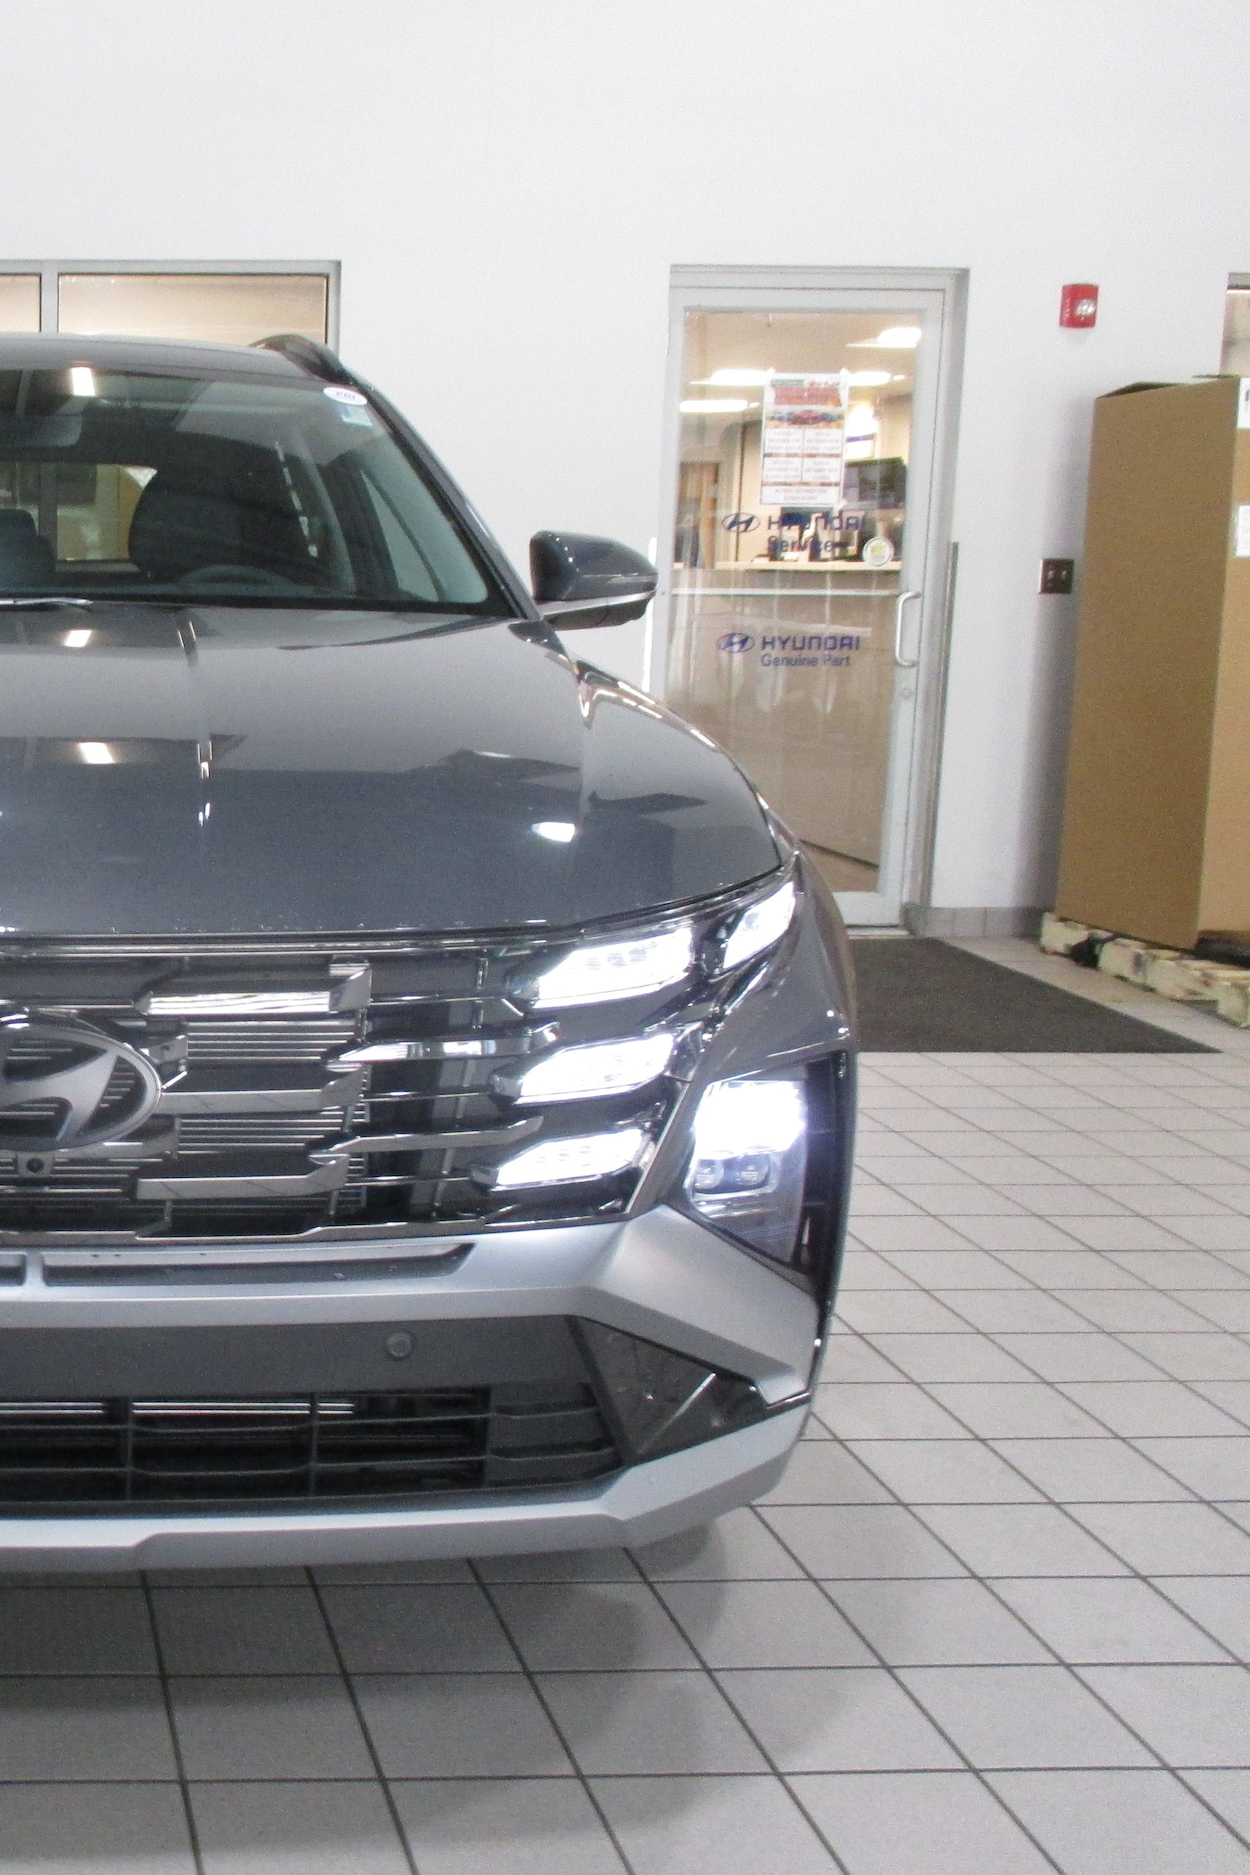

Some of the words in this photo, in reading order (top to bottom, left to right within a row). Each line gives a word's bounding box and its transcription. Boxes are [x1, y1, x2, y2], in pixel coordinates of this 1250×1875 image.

[767, 514, 867, 531] HNDAI
[768, 535, 833, 552] Serve
[761, 635, 861, 651] HYUNDAI
[760, 653, 818, 667] Genuine
[823, 653, 850, 667] Part
